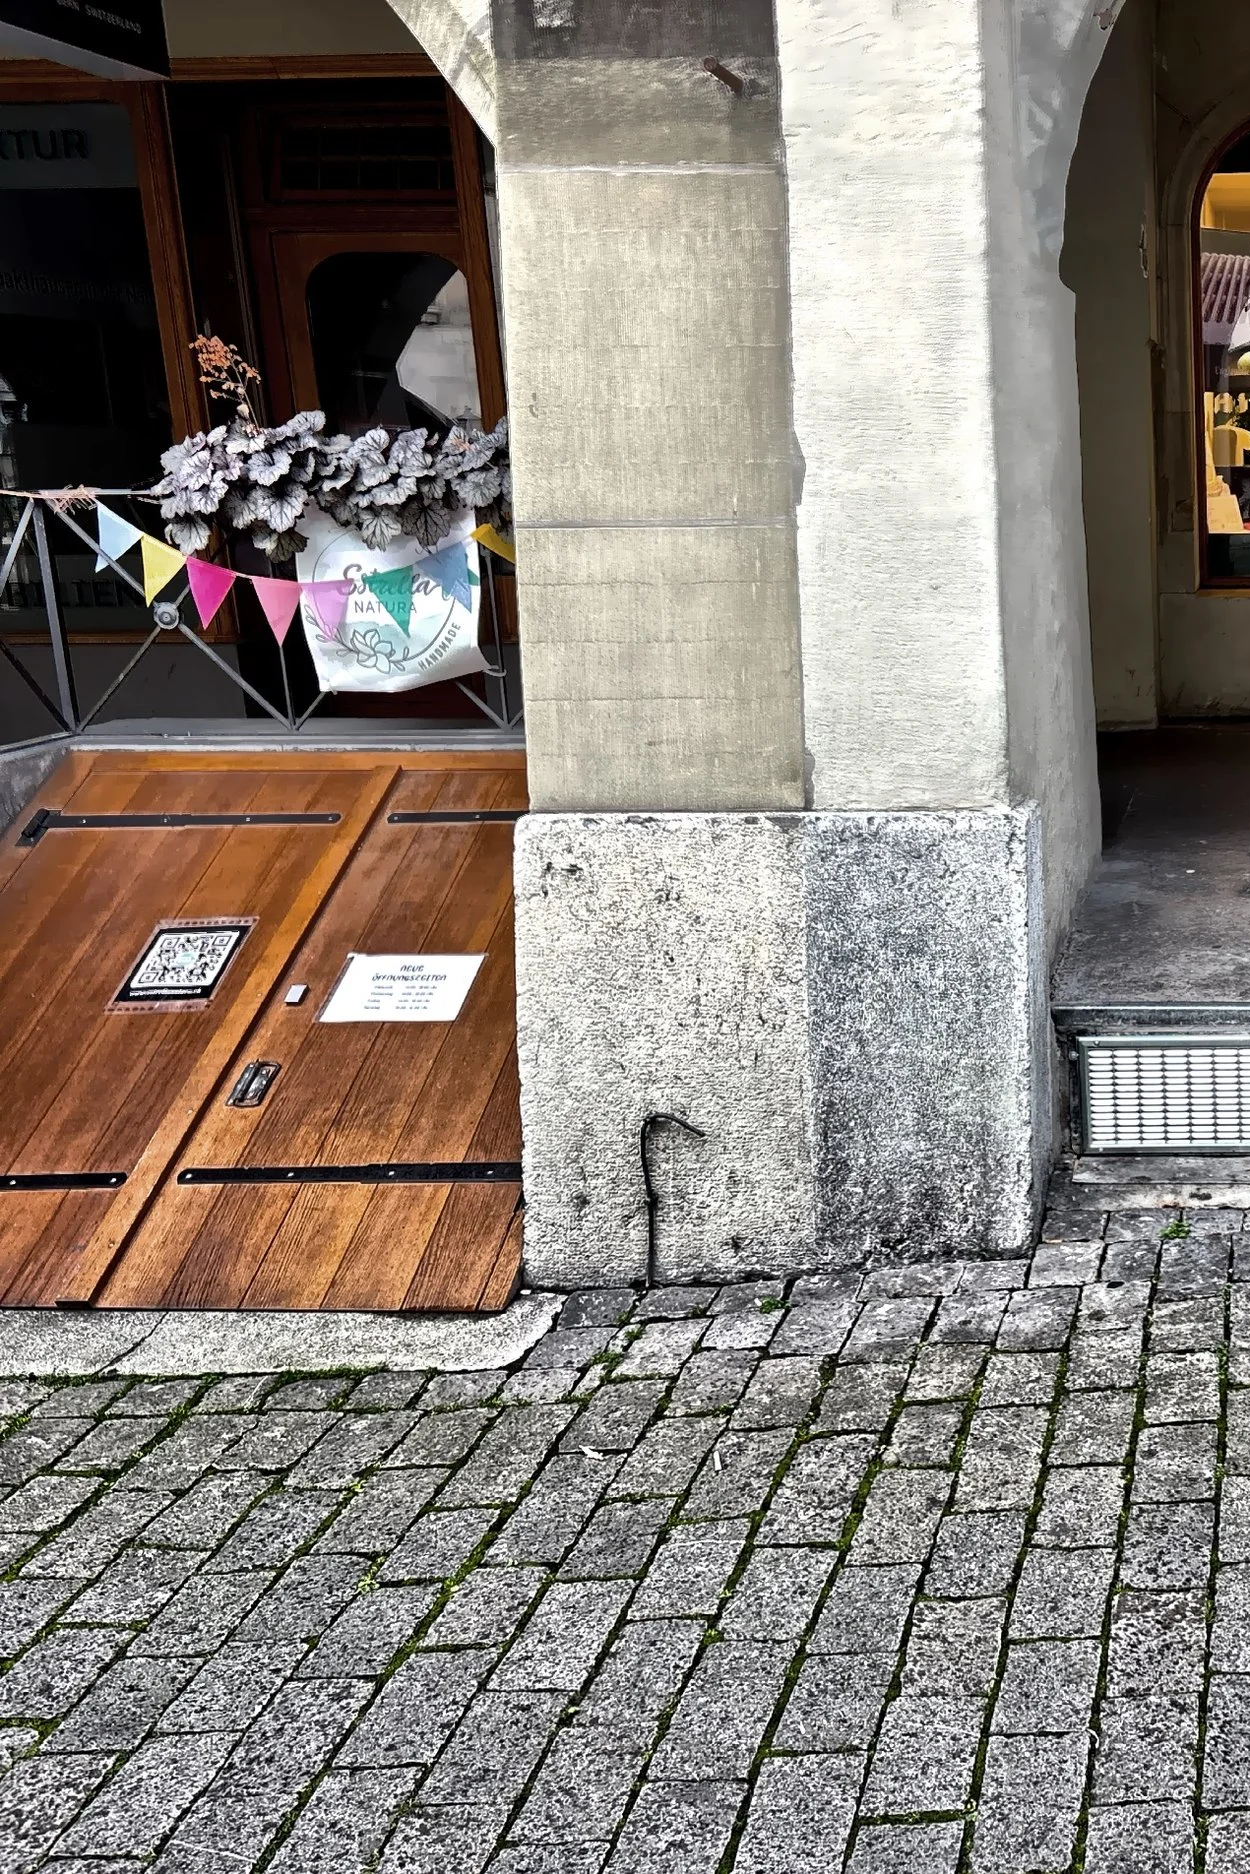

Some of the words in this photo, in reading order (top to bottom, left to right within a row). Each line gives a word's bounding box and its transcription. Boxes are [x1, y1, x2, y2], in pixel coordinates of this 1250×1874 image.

[0, 128, 88, 160] TUR
[336, 563, 442, 597] Estrella
[354, 600, 418, 614] NATURA
[417, 621, 462, 672] HANDMADE
